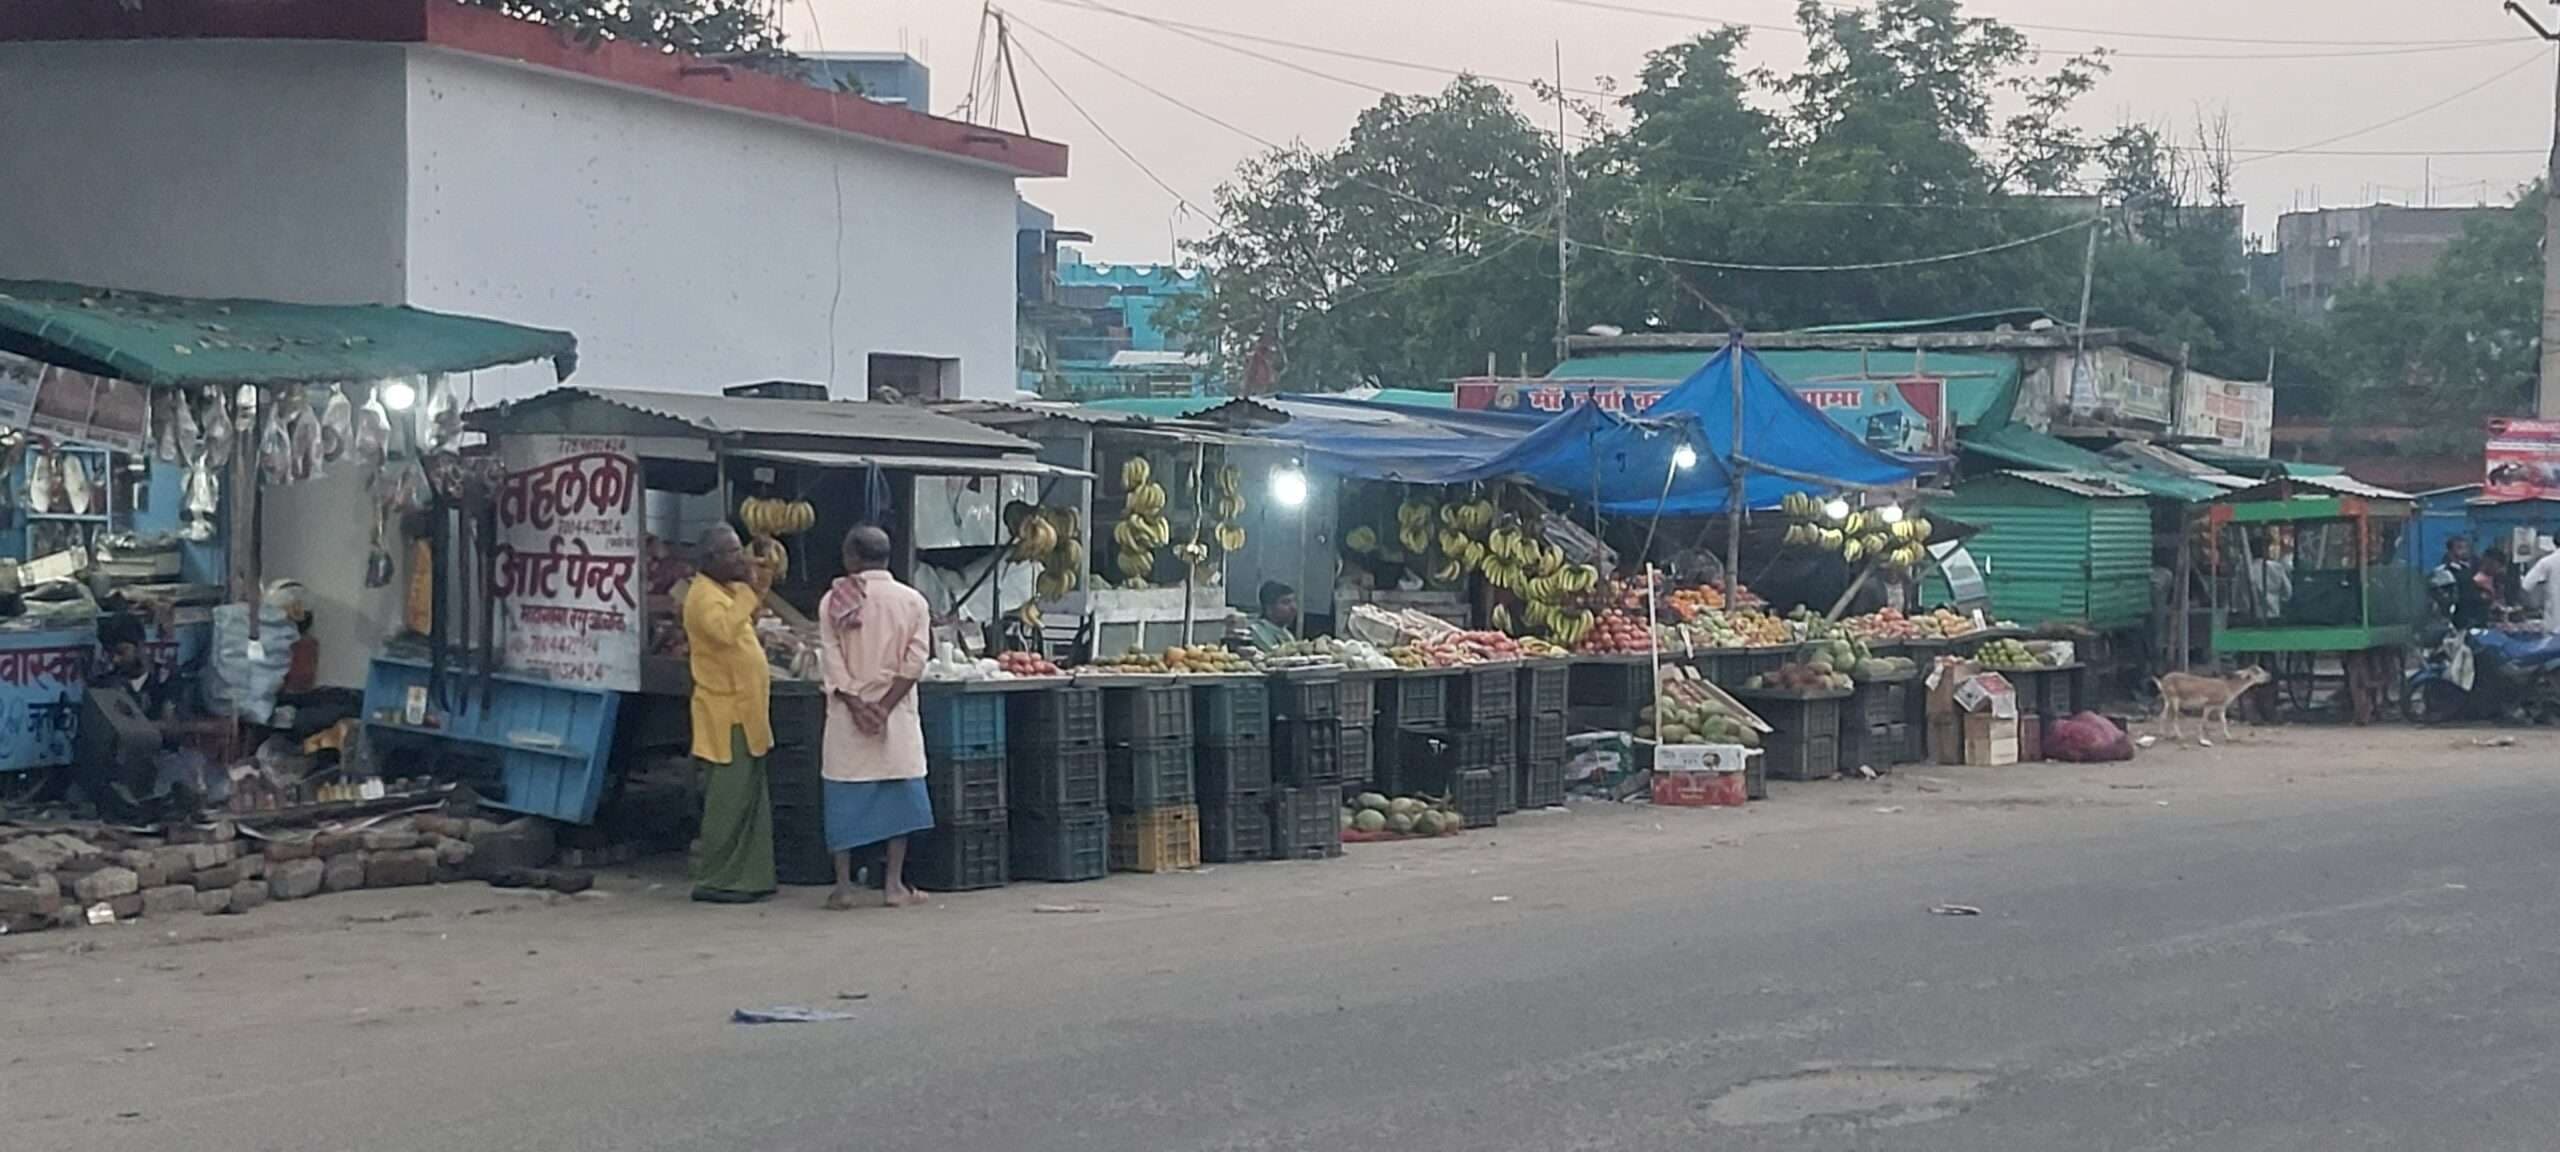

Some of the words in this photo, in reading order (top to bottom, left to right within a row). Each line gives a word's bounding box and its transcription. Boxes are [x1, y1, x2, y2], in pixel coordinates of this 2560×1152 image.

[500, 452, 637, 530] तहलका
[492, 535, 564, 599] आर्ट
[566, 537, 637, 610] पेन्टर
